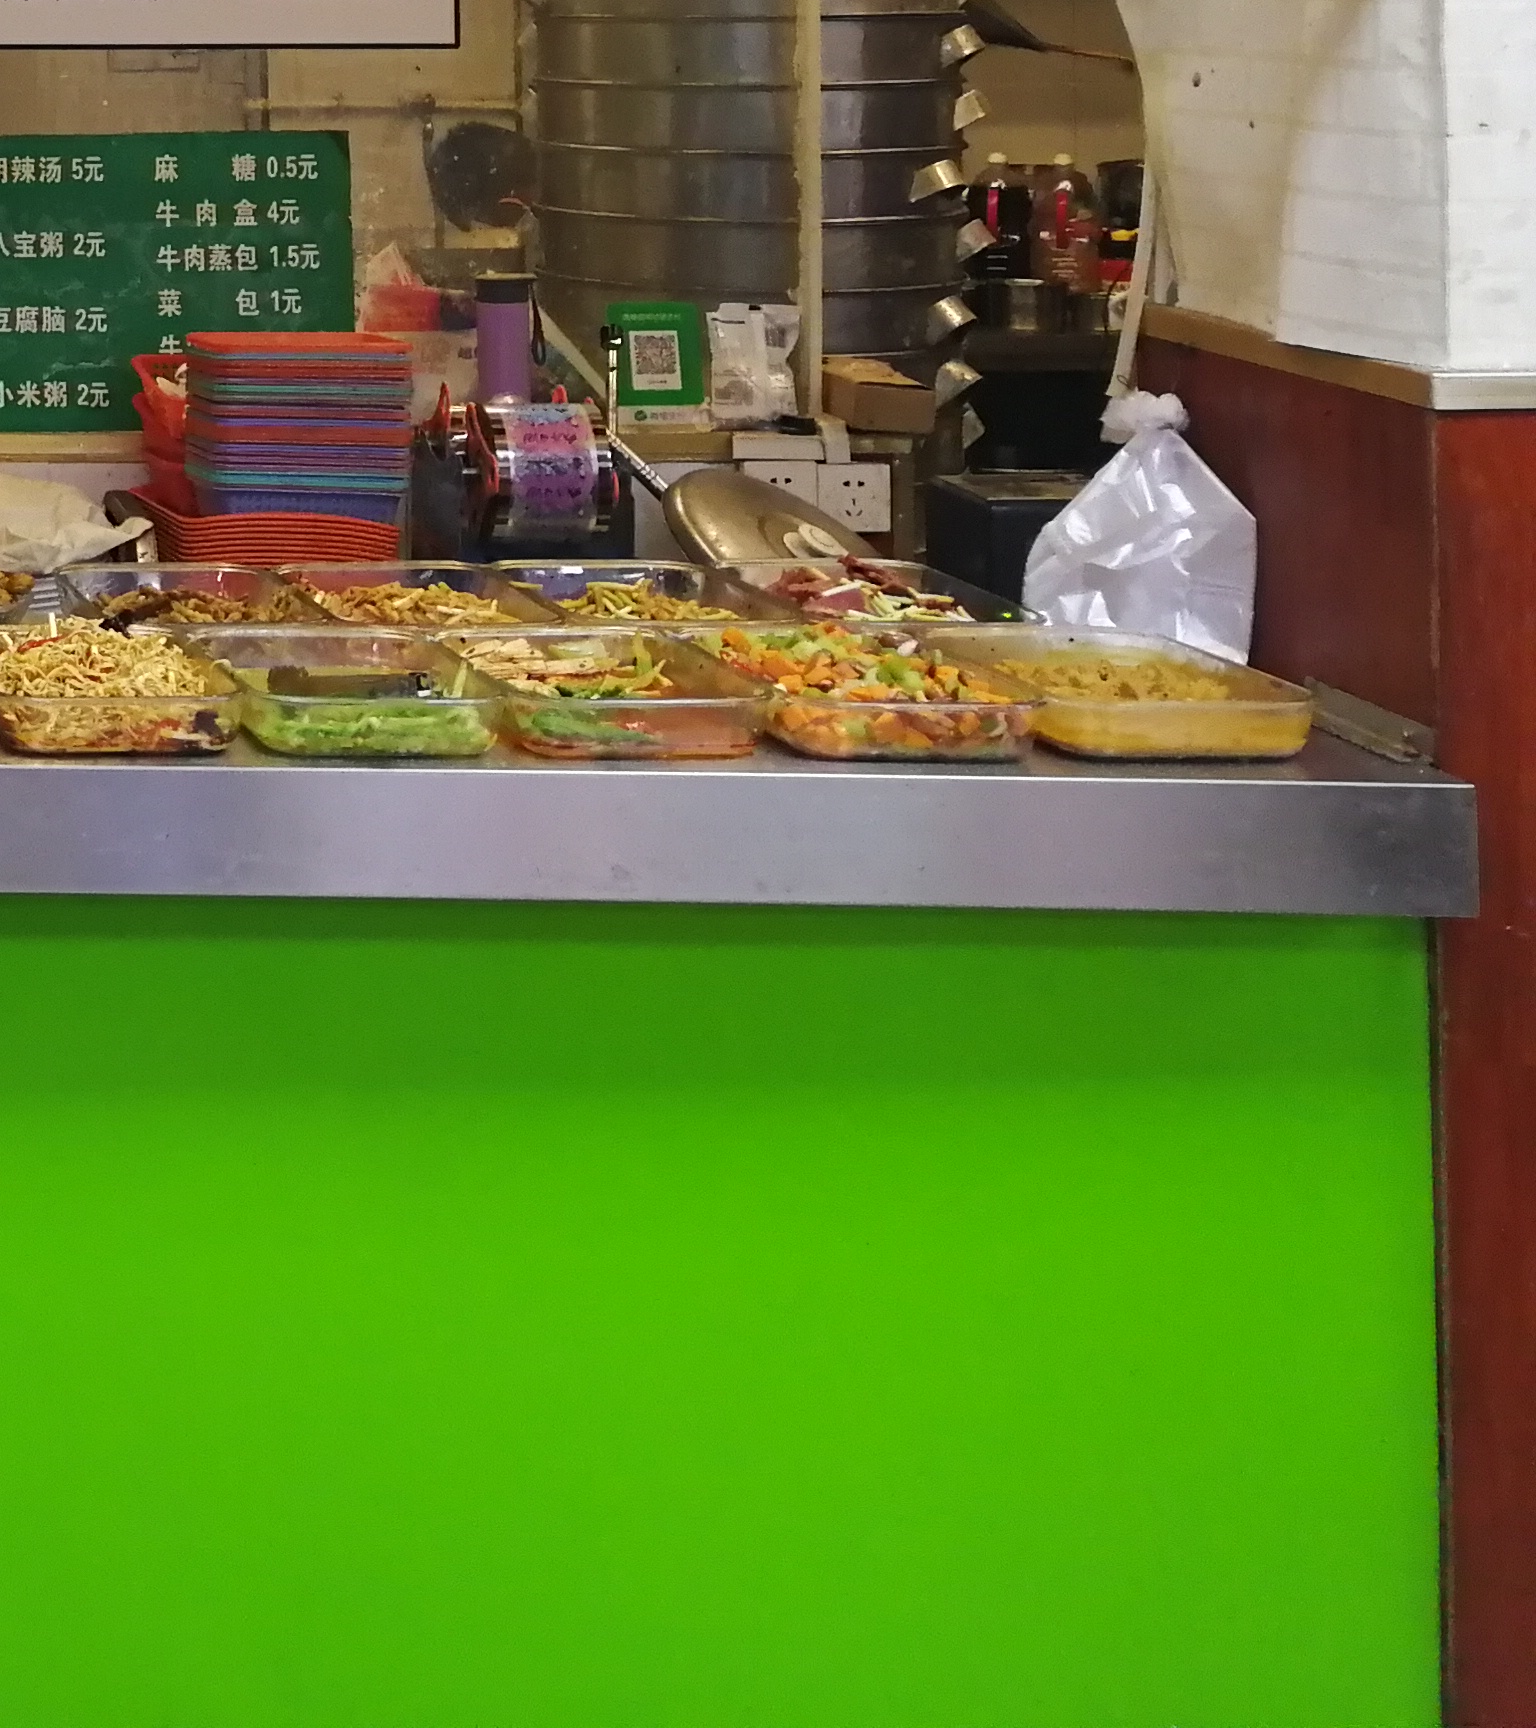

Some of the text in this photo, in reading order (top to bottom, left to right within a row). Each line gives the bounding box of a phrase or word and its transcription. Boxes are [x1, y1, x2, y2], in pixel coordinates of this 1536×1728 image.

[72, 156, 104, 182] 5元
[267, 154, 318, 179] 0.5元
[156, 199, 300, 227] 牛肉盒 4元
[73, 232, 105, 257] 2元
[156, 244, 320, 272] 牛肉蒸包 1.5元
[271, 289, 301, 314] 1元
[75, 307, 107, 332] 2元
[77, 382, 109, 407] 2元
